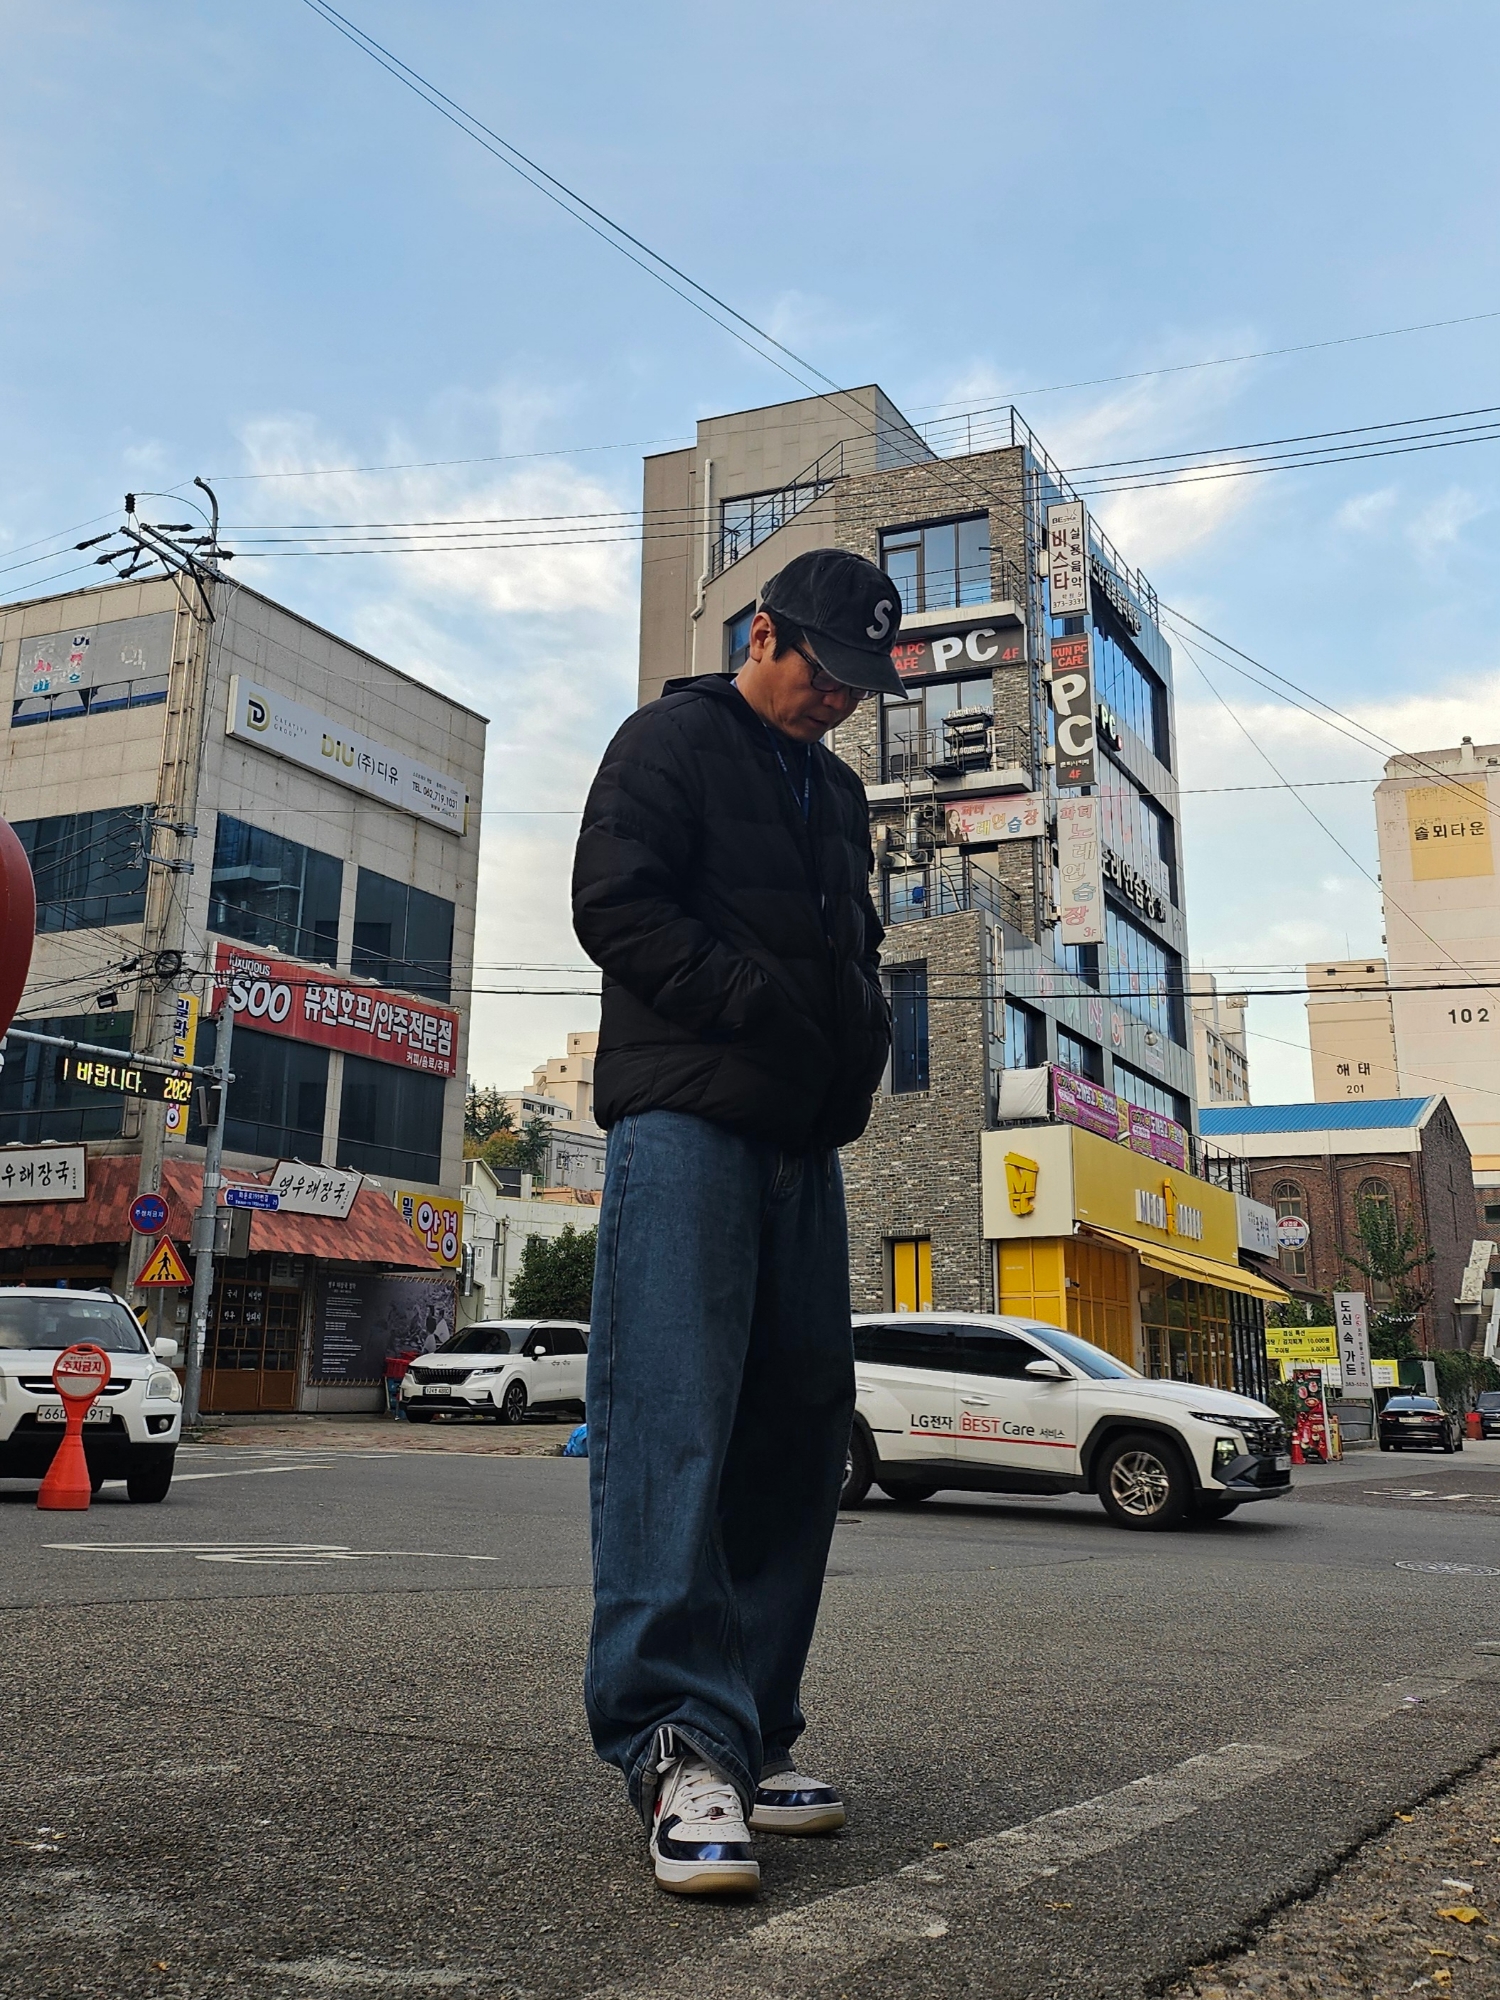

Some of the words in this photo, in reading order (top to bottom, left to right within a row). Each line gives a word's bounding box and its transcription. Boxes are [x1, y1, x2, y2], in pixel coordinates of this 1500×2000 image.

[1052, 529, 1069, 590] 비스타
[1070, 527, 1083, 588] 실용음악
[866, 599, 893, 640] S
[906, 642, 926, 656] PC
[931, 627, 999, 672] PC
[1002, 647, 1020, 661] 4F
[1052, 645, 1073, 658] KUN
[1074, 643, 1088, 655] PC
[1058, 655, 1084, 668] CAFE
[895, 657, 919, 670] AFE
[1051, 673, 1094, 757] PC
[1101, 703, 1117, 741] PC
[357, 752, 399, 787] (주)디유
[1068, 769, 1082, 779] 4F
[960, 808, 1040, 836] 노래연습장
[1062, 823, 1098, 926] 노래연습장
[1083, 926, 1098, 938] 3F
[229, 979, 293, 1023] SOO
[1448, 1007, 1490, 1026] 102
[405, 1050, 451, 1074] 커피/음료/주류
[1336, 1061, 1371, 1077] 해태
[76, 1061, 147, 1093] 바랍니다.
[1346, 1084, 1365, 1095] 201
[1, 1160, 70, 1188] 우해장국
[279, 1174, 346, 1205] 영우해장국
[135, 1209, 164, 1218] 주정차금지
[416, 1201, 459, 1262] 안경
[1340, 1300, 1353, 1326] 도심
[1343, 1331, 1354, 1345] 속
[62, 1361, 102, 1373] 주차금지
[1344, 1350, 1357, 1376] 가든
[910, 1413, 954, 1430] LG전자
[962, 1417, 1001, 1434] BEST
[1002, 1421, 1035, 1437] Care
[1039, 1428, 1066, 1440] 서비스
